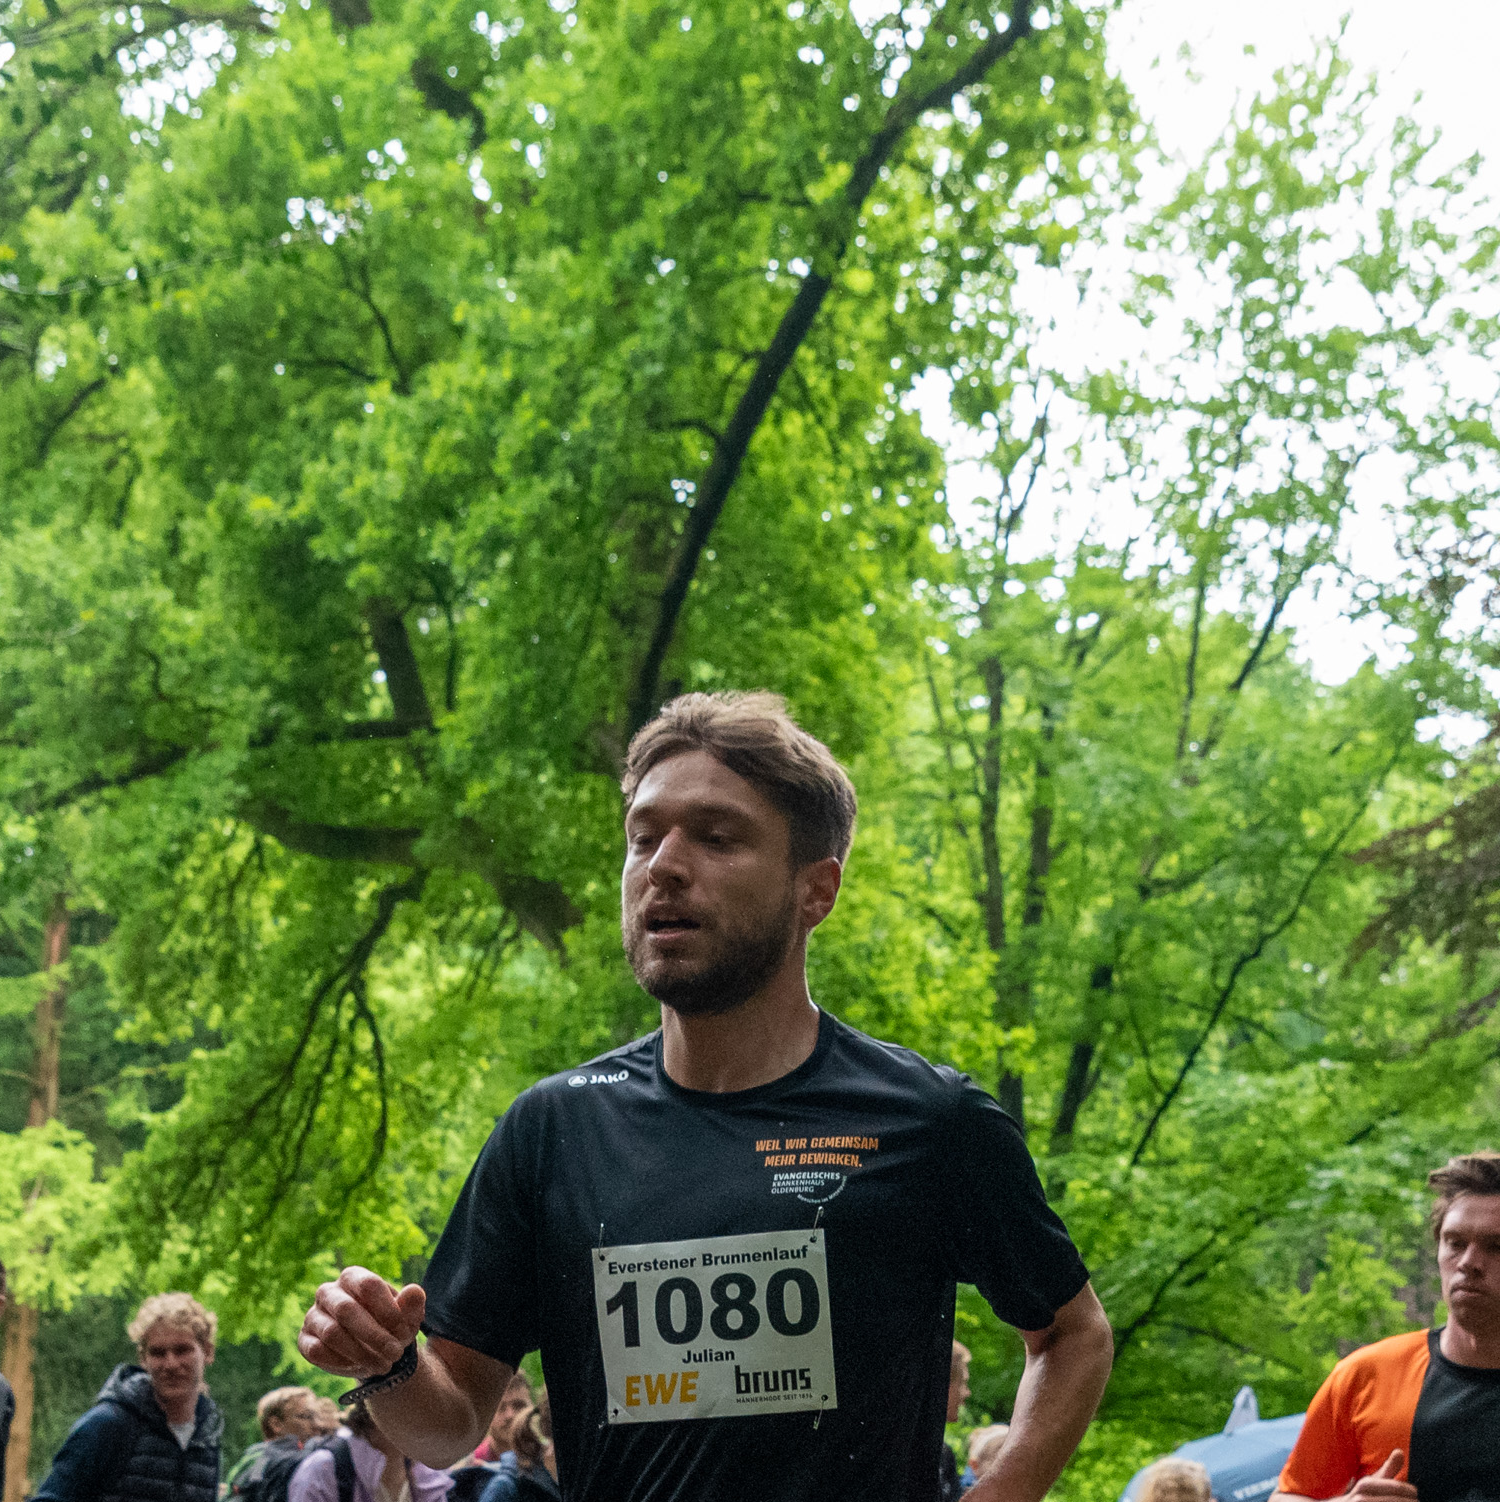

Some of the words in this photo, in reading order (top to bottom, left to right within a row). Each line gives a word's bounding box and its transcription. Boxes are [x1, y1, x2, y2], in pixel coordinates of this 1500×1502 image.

[589, 1069, 629, 1084] JAKO
[755, 1139, 781, 1152] WEIL
[785, 1137, 808, 1150] WIR
[810, 1136, 879, 1151] GEMEINSAM
[764, 1154, 796, 1167] MEHR
[799, 1152, 863, 1168] BEWIRKEN.
[772, 1179, 825, 1187] KRANKENHAUS
[773, 1171, 841, 1181] EVANGELISCHES
[771, 1186, 815, 1194] OLDENBURG
[608, 1256, 697, 1275] Everstener
[702, 1245, 808, 1267] Brunnenlauf
[605, 1267, 821, 1348] 1080
[681, 1349, 735, 1364] Julian
[734, 1364, 812, 1395] bruns
[625, 1370, 699, 1407] EWE
